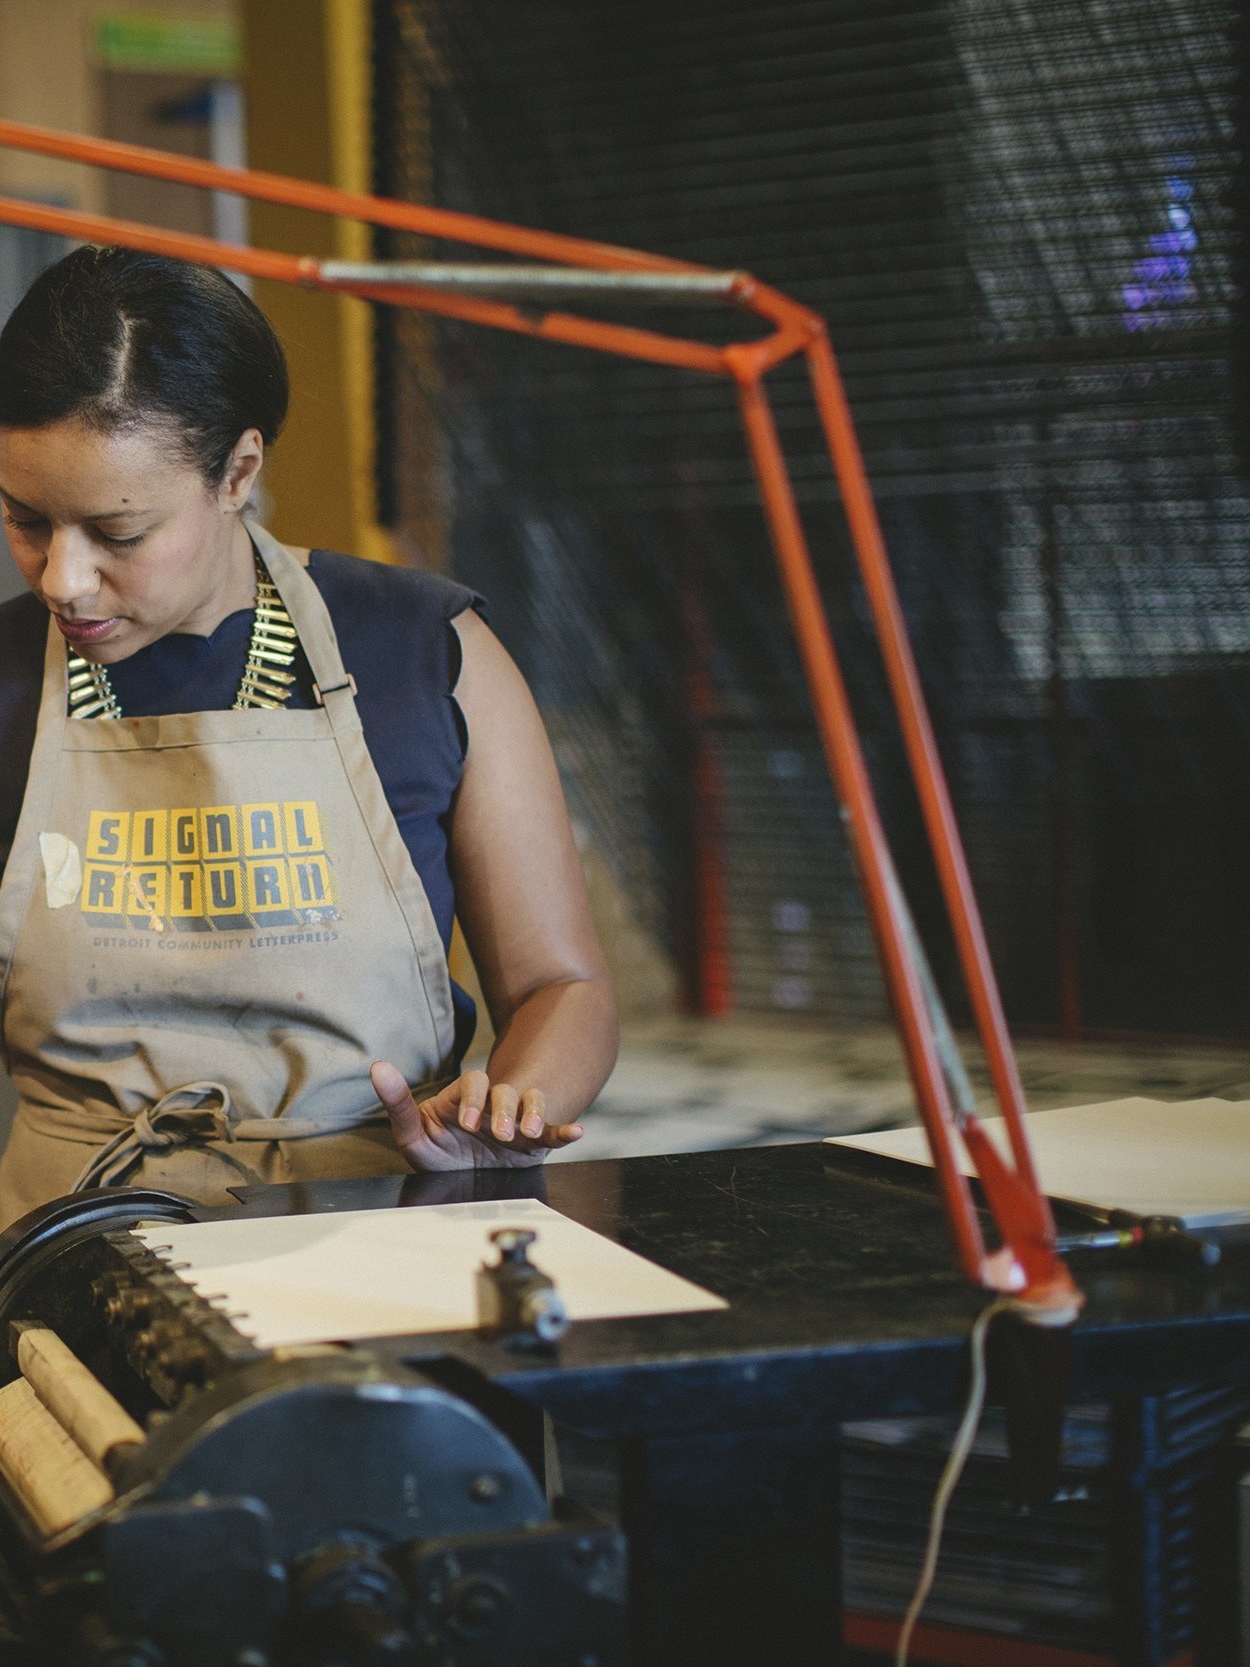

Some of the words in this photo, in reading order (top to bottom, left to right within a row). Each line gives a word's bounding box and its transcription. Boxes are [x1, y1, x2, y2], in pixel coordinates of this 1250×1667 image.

[97, 808, 313, 856] SIGNAL
[88, 863, 325, 911] RETURN
[93, 936, 150, 948] DETROIT
[157, 939, 242, 951] COMMUNITY
[250, 931, 339, 948] LETTERPRESS
